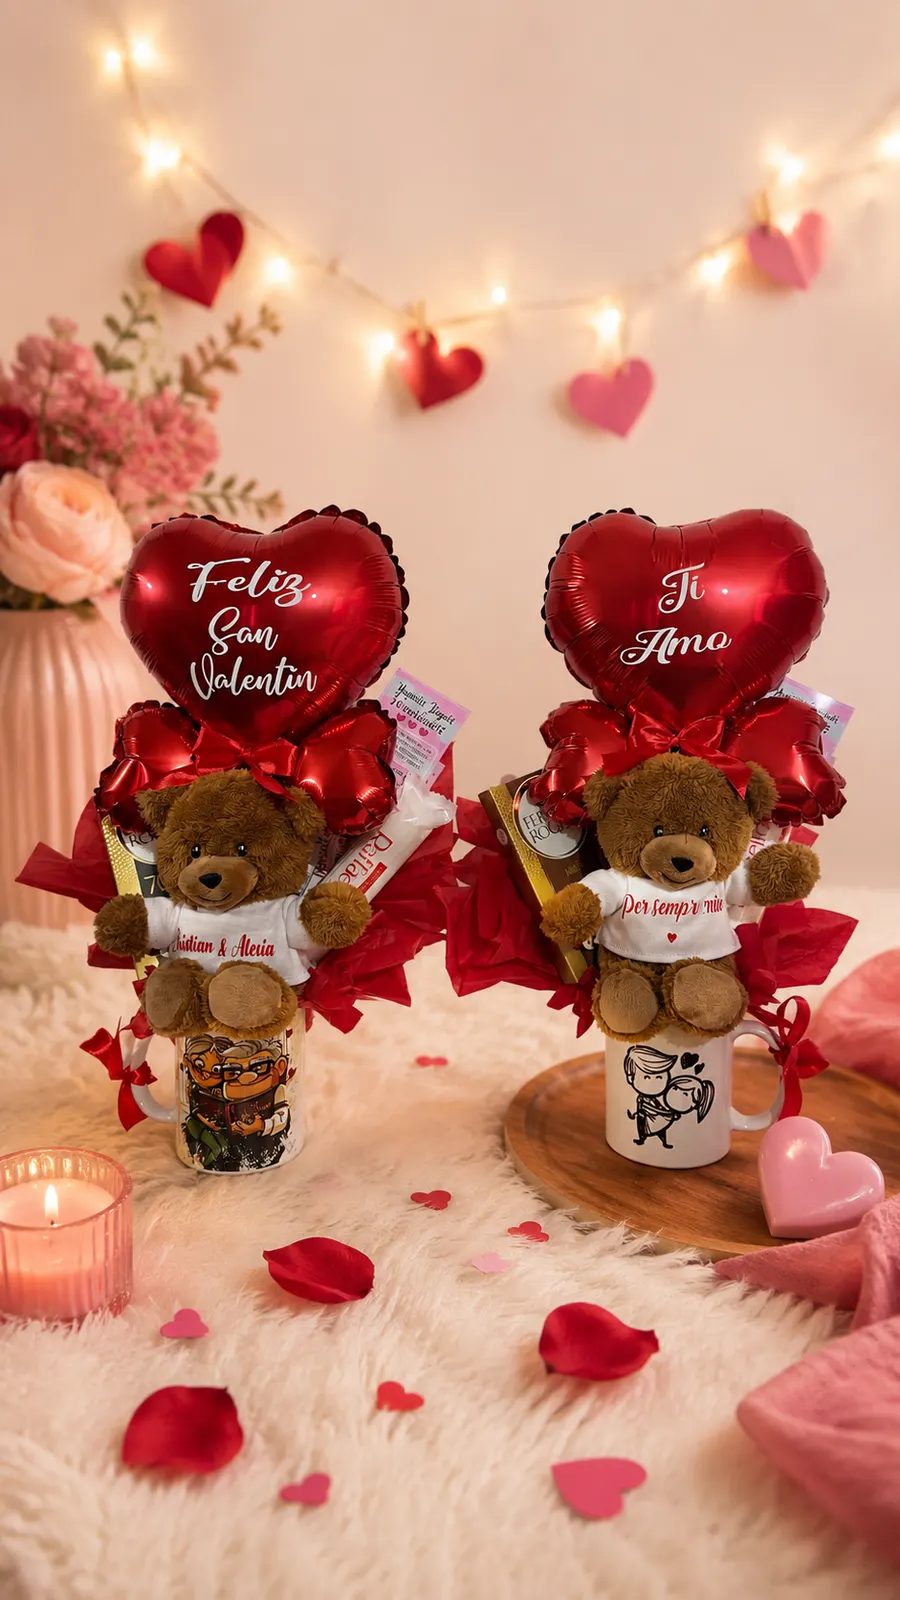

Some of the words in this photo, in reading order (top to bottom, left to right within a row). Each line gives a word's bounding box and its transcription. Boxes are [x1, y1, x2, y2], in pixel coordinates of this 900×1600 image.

[187, 557, 311, 608] Feliz
[658, 562, 706, 614] Ti
[208, 606, 279, 656] San
[619, 627, 732, 665] Amo
[190, 652, 318, 701] Valentin
[523, 811, 545, 829] FER
[529, 824, 560, 844] ROC
[129, 831, 155, 847] RO
[621, 894, 649, 919] Per
[652, 898, 701, 922] sempr
[217, 938, 227, 957] &
